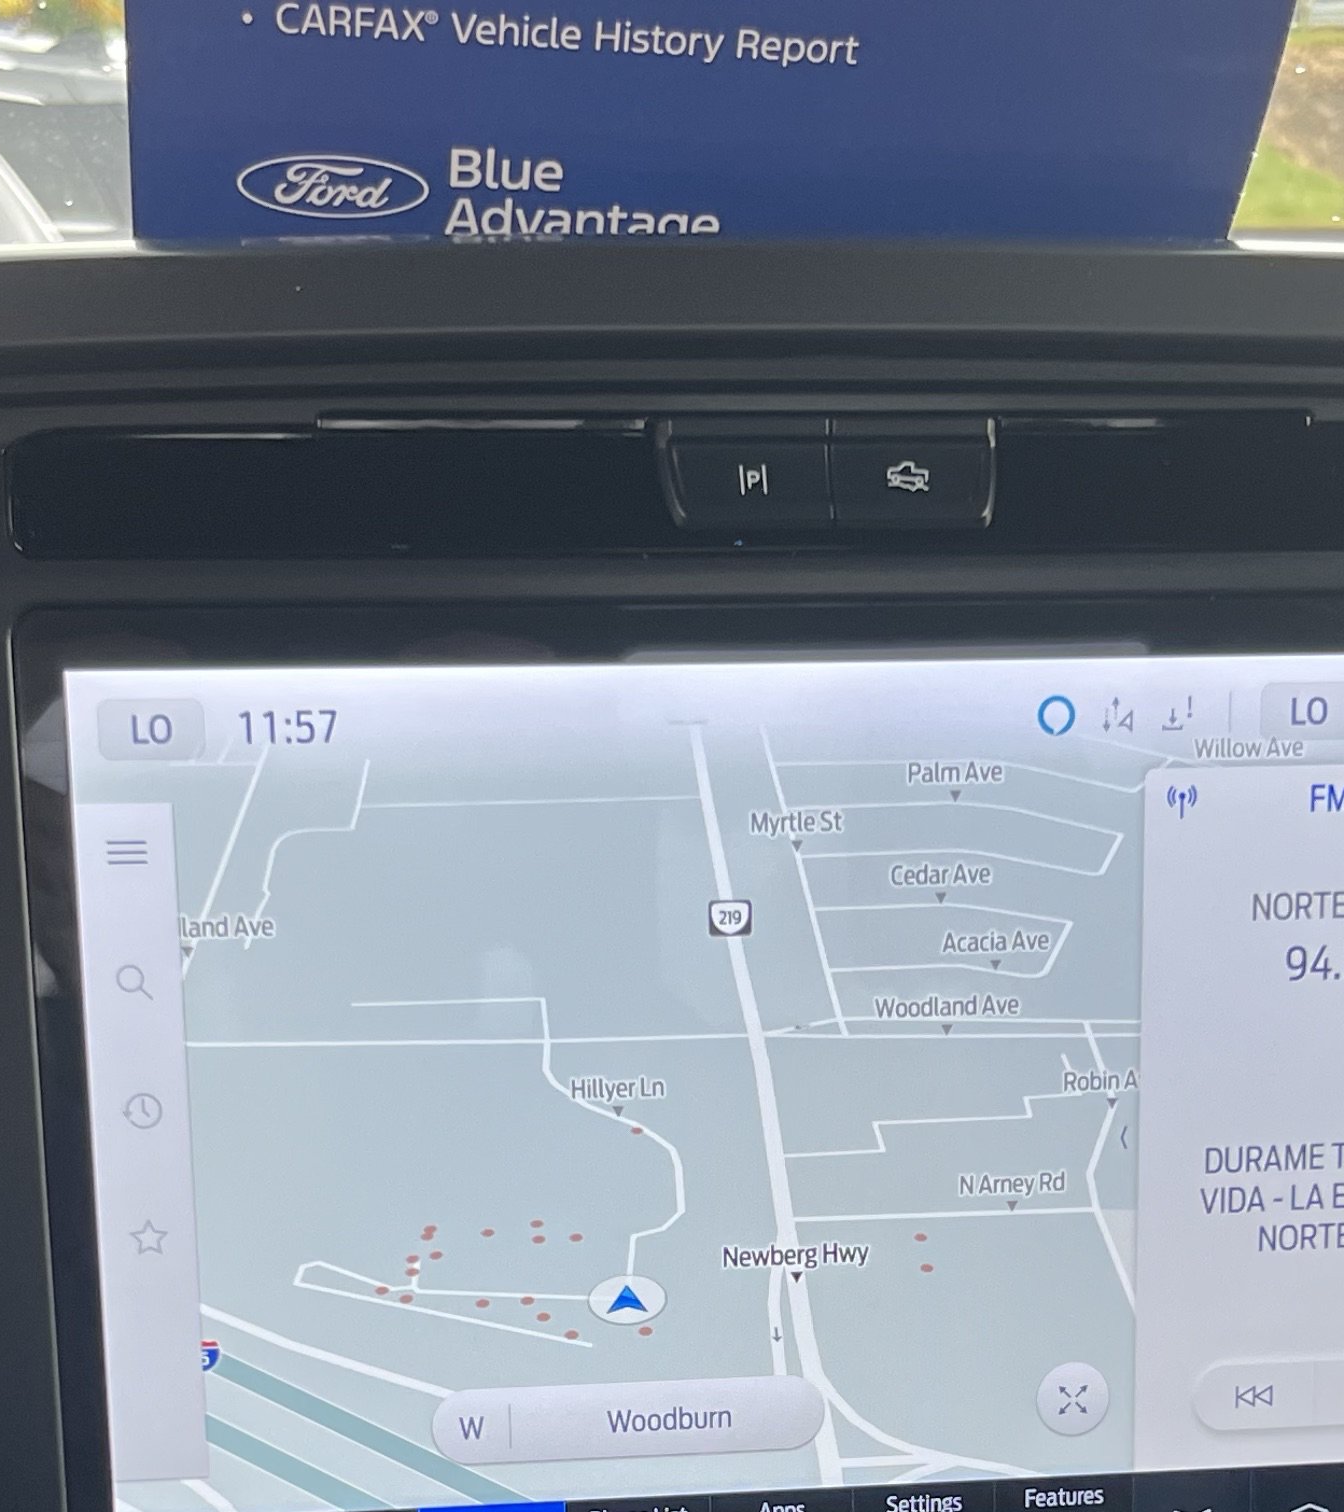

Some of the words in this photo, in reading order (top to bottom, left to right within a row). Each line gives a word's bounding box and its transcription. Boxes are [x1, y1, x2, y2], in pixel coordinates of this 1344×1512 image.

[452, 12, 582, 51] Vehicle
[595, 21, 725, 65] History
[736, 29, 860, 67] Report
[449, 148, 564, 192] Blue
[1290, 696, 1329, 727] LO
[131, 714, 173, 745] LO
[238, 709, 338, 745] 11:57
[1194, 738, 1262, 759] Willow
[1266, 737, 1304, 758] Ave
[907, 762, 960, 784] Palm
[965, 762, 1003, 783] Ave
[751, 811, 816, 838] Myrtle
[819, 811, 842, 833] St
[891, 865, 949, 887] Cedar
[954, 865, 991, 885] Ave
[178, 915, 229, 938] land
[235, 915, 274, 937] Ave
[719, 909, 743, 928] 219
[942, 932, 1007, 954] Acacia
[1011, 932, 1050, 952] Ave
[875, 998, 977, 1020] Woodland
[981, 997, 1020, 1017] Ave
[570, 1077, 634, 1104] Hillyer
[639, 1076, 665, 1098] Ln
[1063, 1071, 1120, 1092] Robin
[1124, 1069, 1140, 1090] A
[1204, 1143, 1325, 1175] DURAME
[960, 1175, 973, 1195] N
[978, 1173, 1035, 1198] Arney
[1039, 1171, 1066, 1192] Rd
[1200, 1186, 1265, 1215] VIDA
[1290, 1182, 1324, 1212] LA
[722, 1244, 817, 1270] Newberg
[823, 1243, 869, 1268] Hwy
[459, 1416, 484, 1441] W
[607, 1406, 733, 1434] Woodburn
[1024, 1485, 1104, 1511] Features
